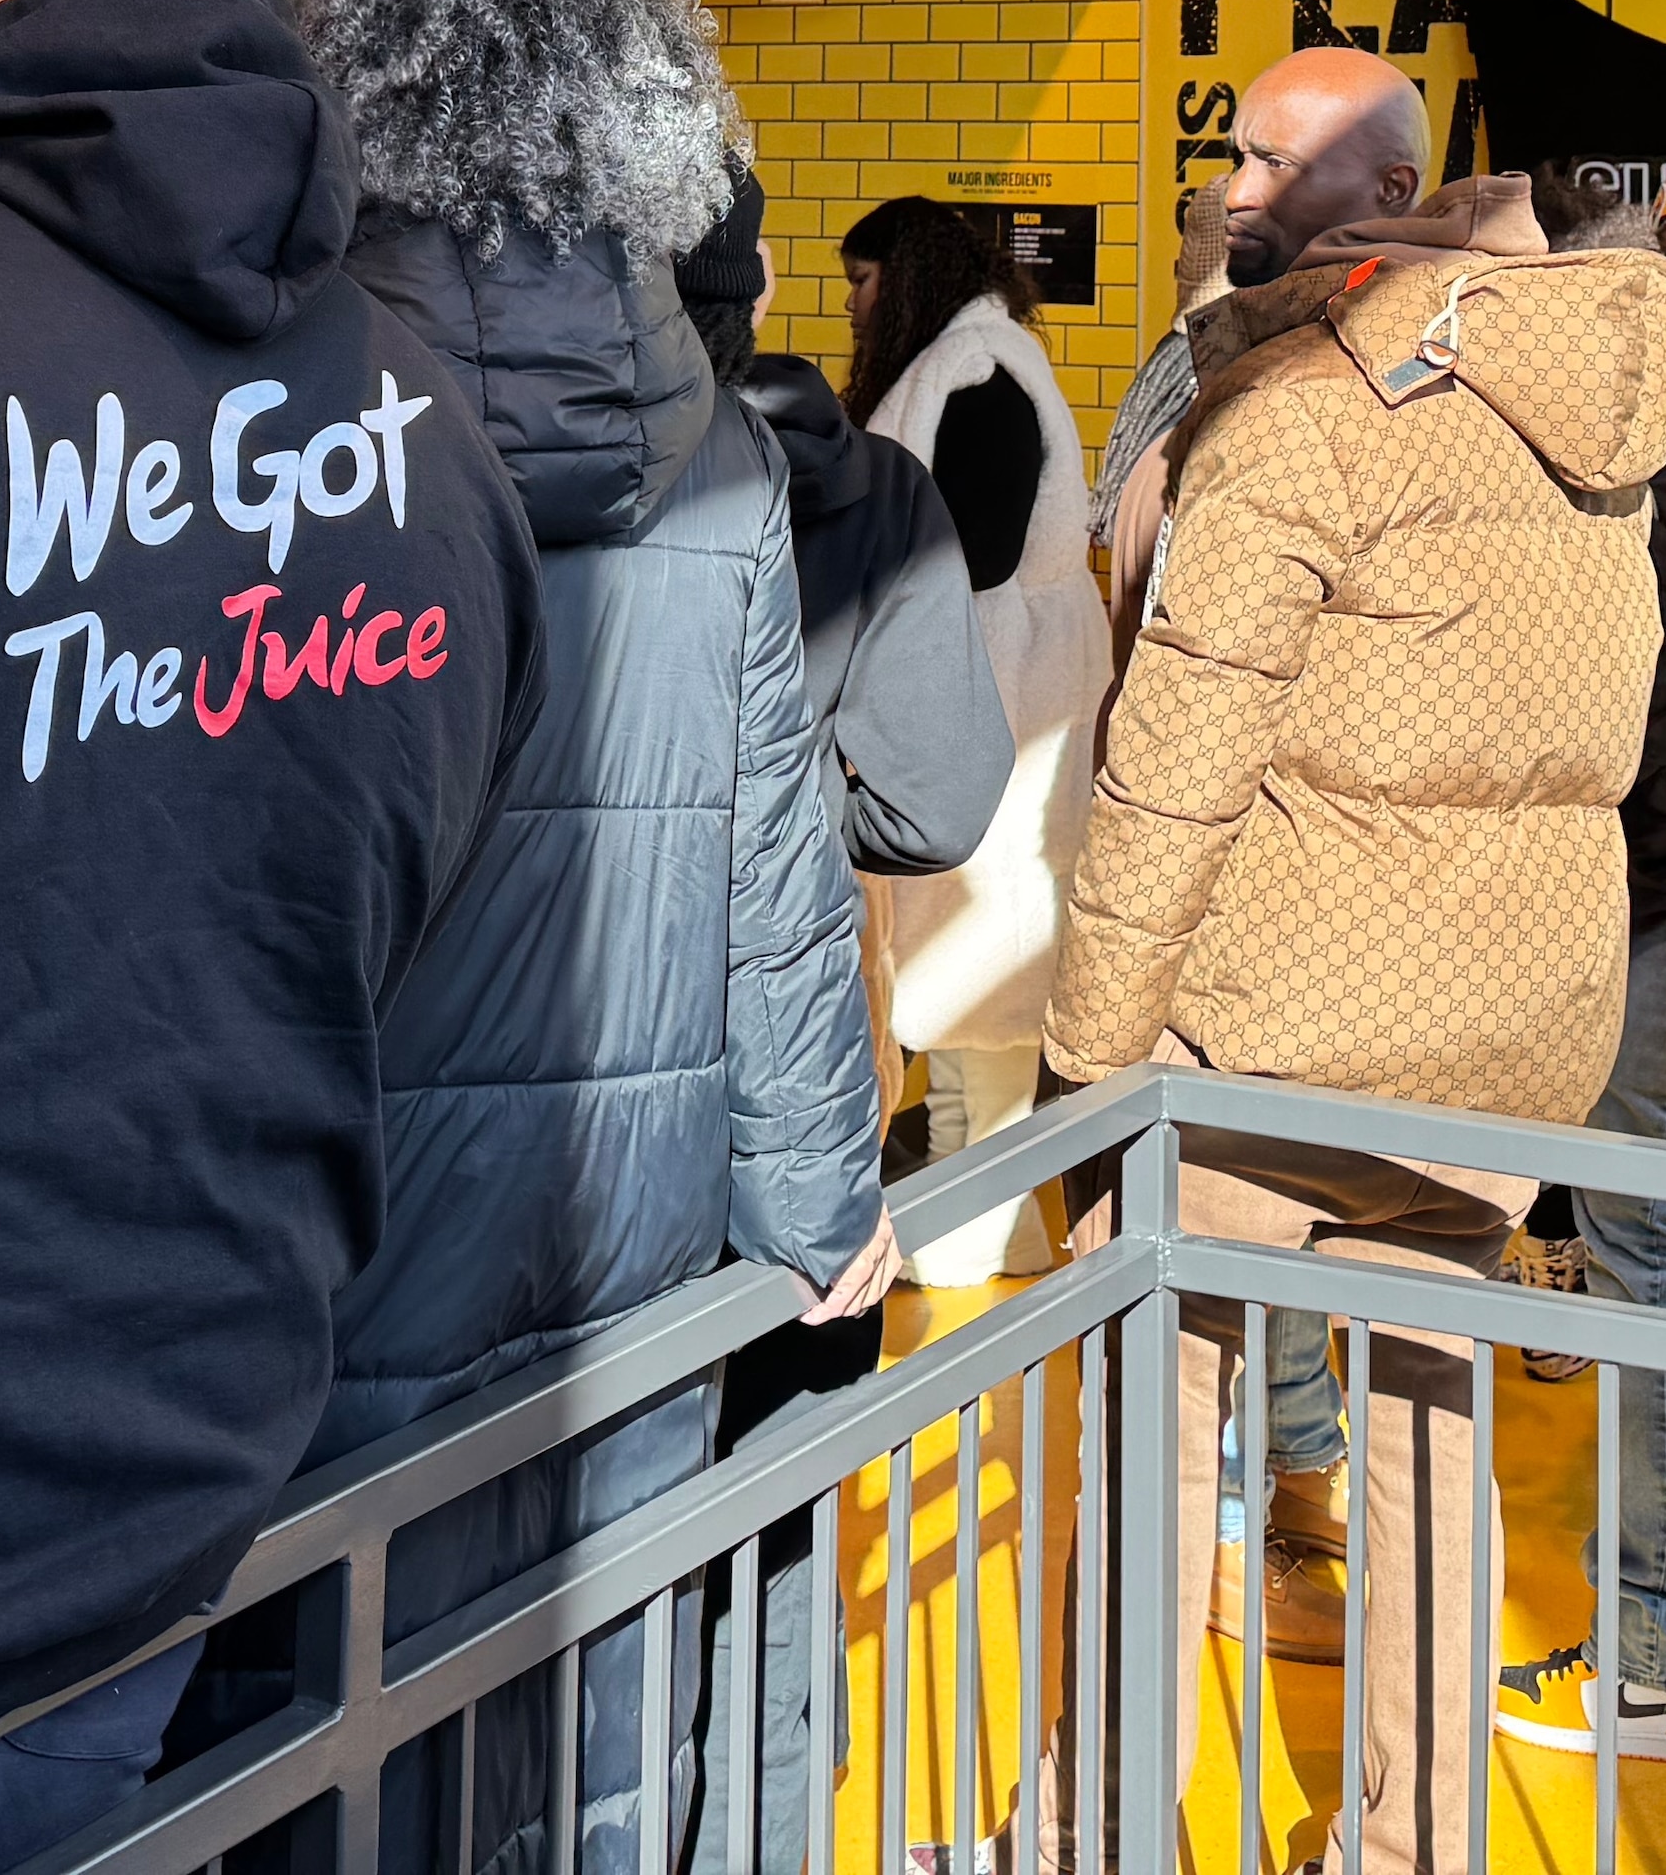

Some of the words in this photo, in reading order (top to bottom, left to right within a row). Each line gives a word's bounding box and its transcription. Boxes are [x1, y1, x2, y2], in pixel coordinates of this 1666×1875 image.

[947, 170, 982, 187] MAJOR
[983, 171, 1053, 189] INGREDIENTS
[4, 391, 194, 598] We
[209, 369, 434, 576] Got
[4, 610, 183, 784] The
[192, 581, 449, 739] Juice
